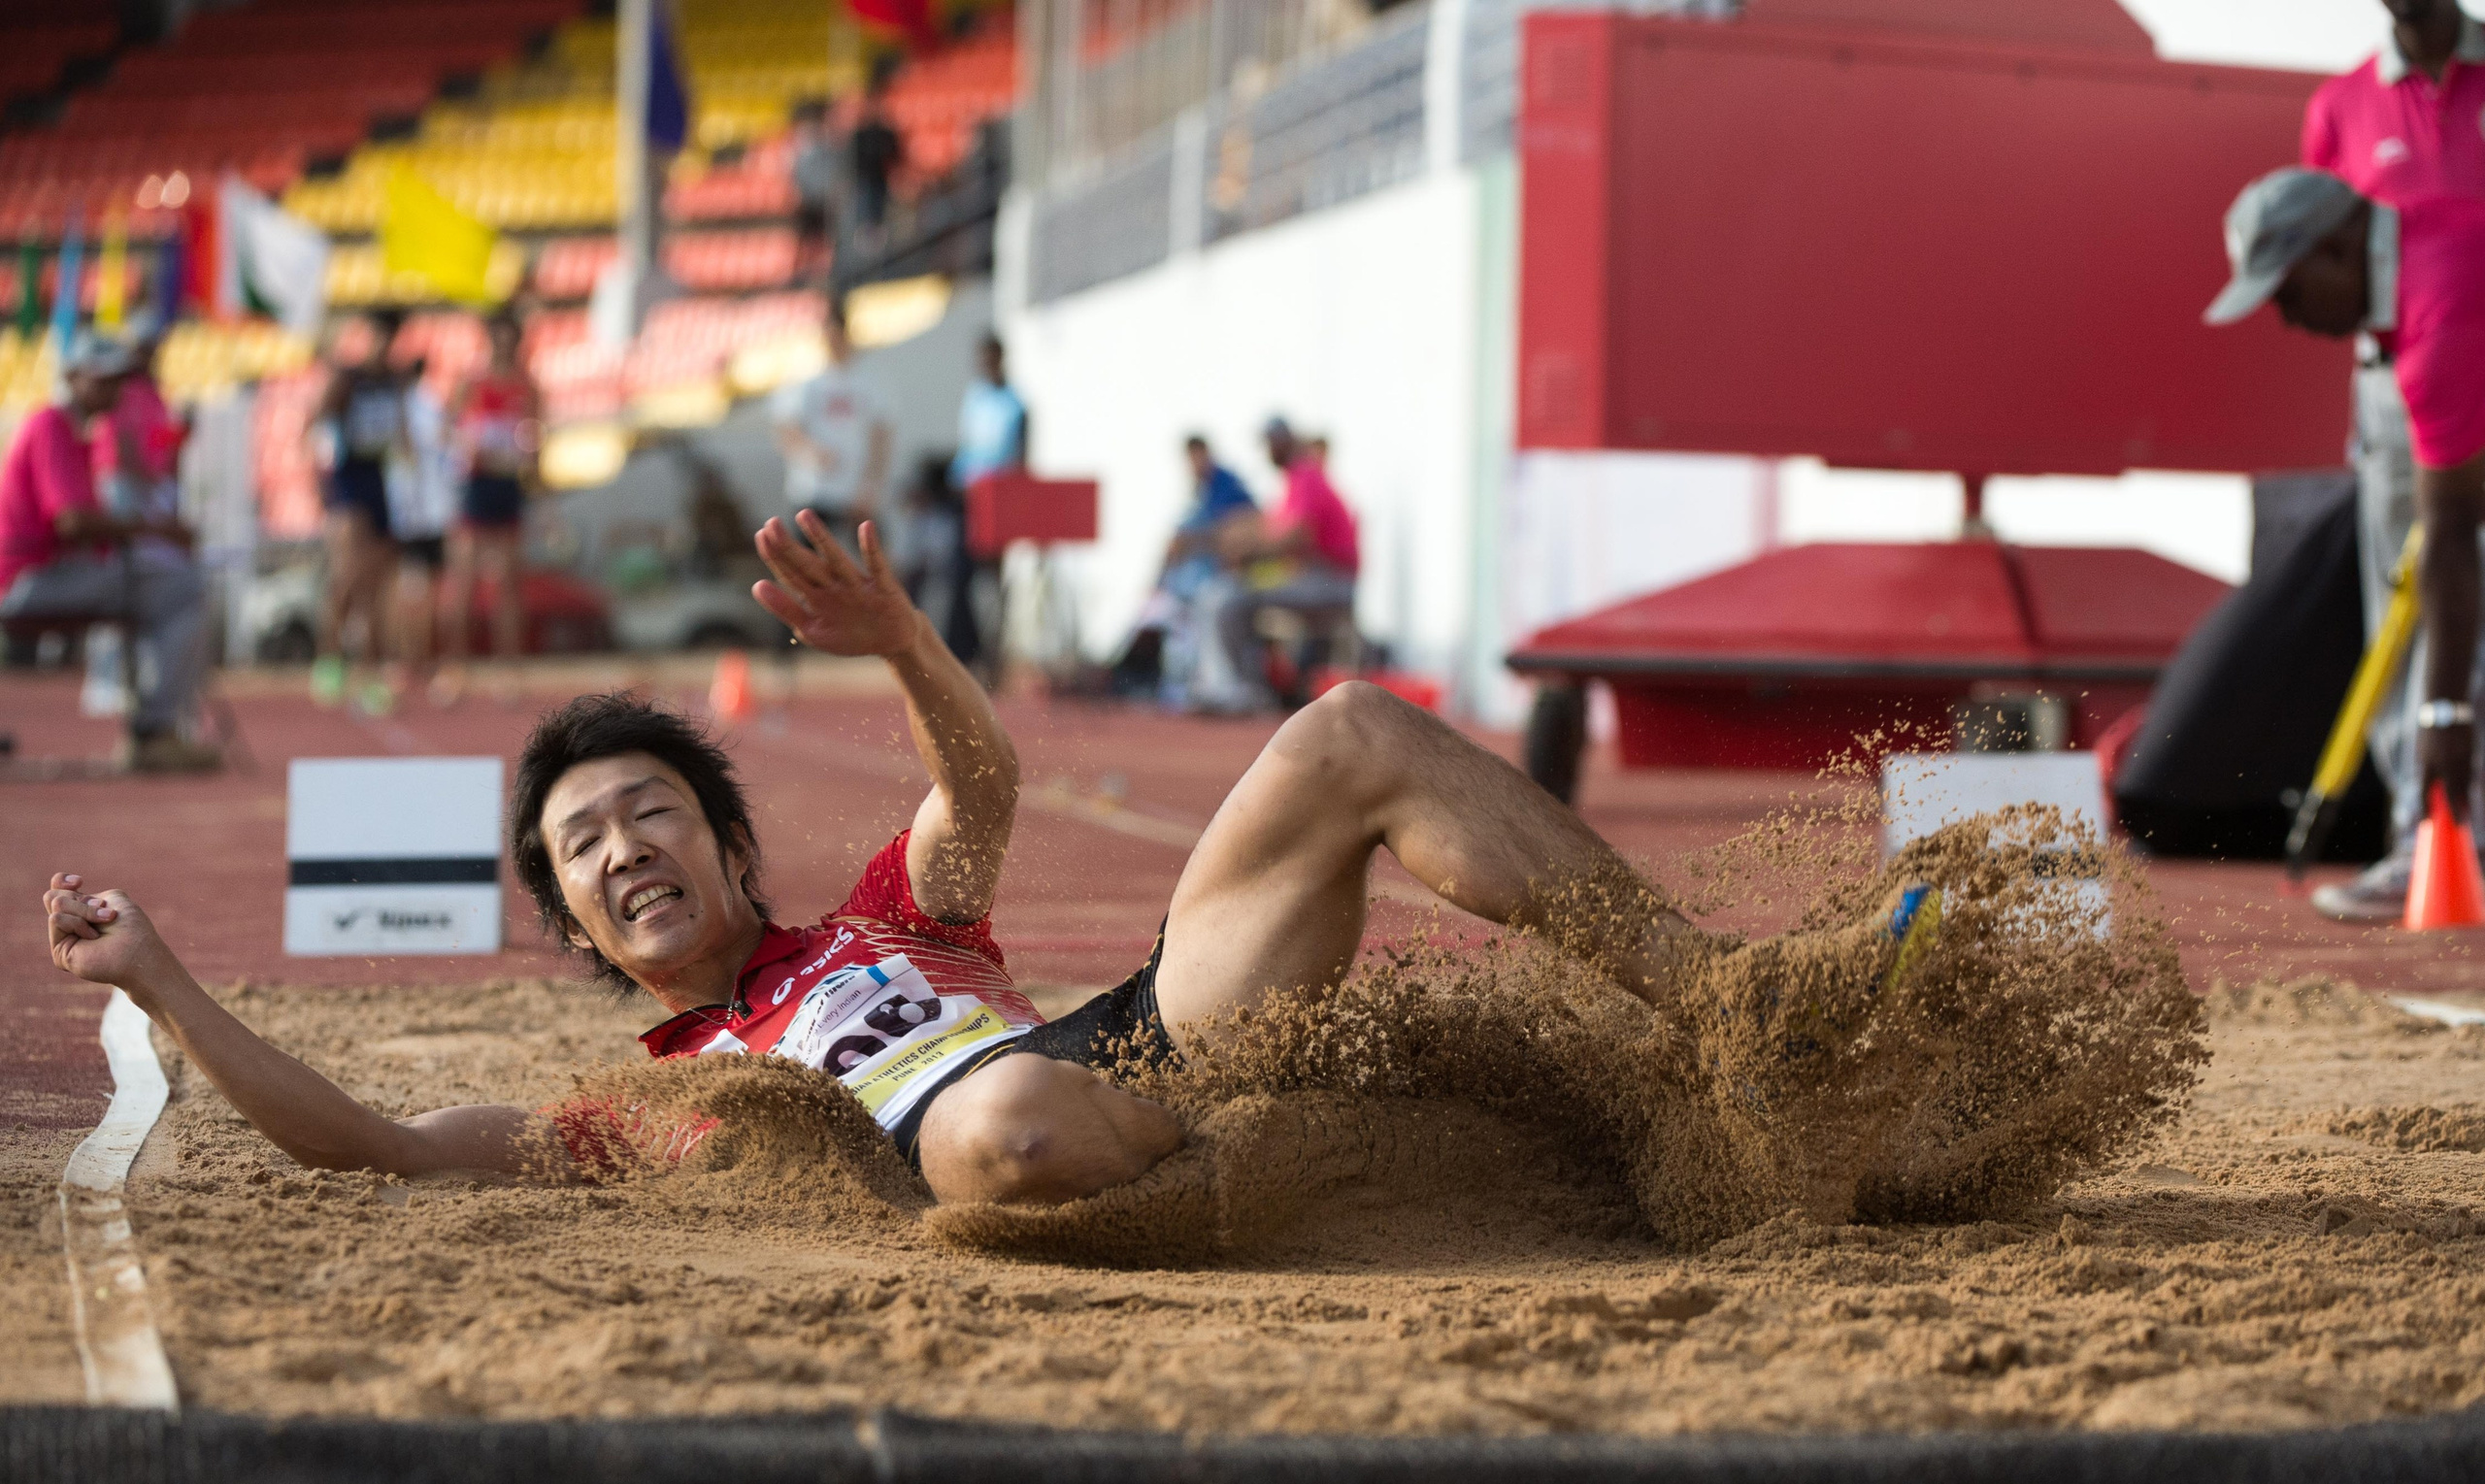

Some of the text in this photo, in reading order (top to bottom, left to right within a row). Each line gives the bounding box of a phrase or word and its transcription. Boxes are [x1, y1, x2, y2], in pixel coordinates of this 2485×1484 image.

[800, 926, 854, 976] asics
[838, 989, 862, 1011] Indian
[851, 1080, 872, 1096] SIAN
[873, 1052, 919, 1085] ATHLETICS
[921, 1050, 944, 1066] 2013
